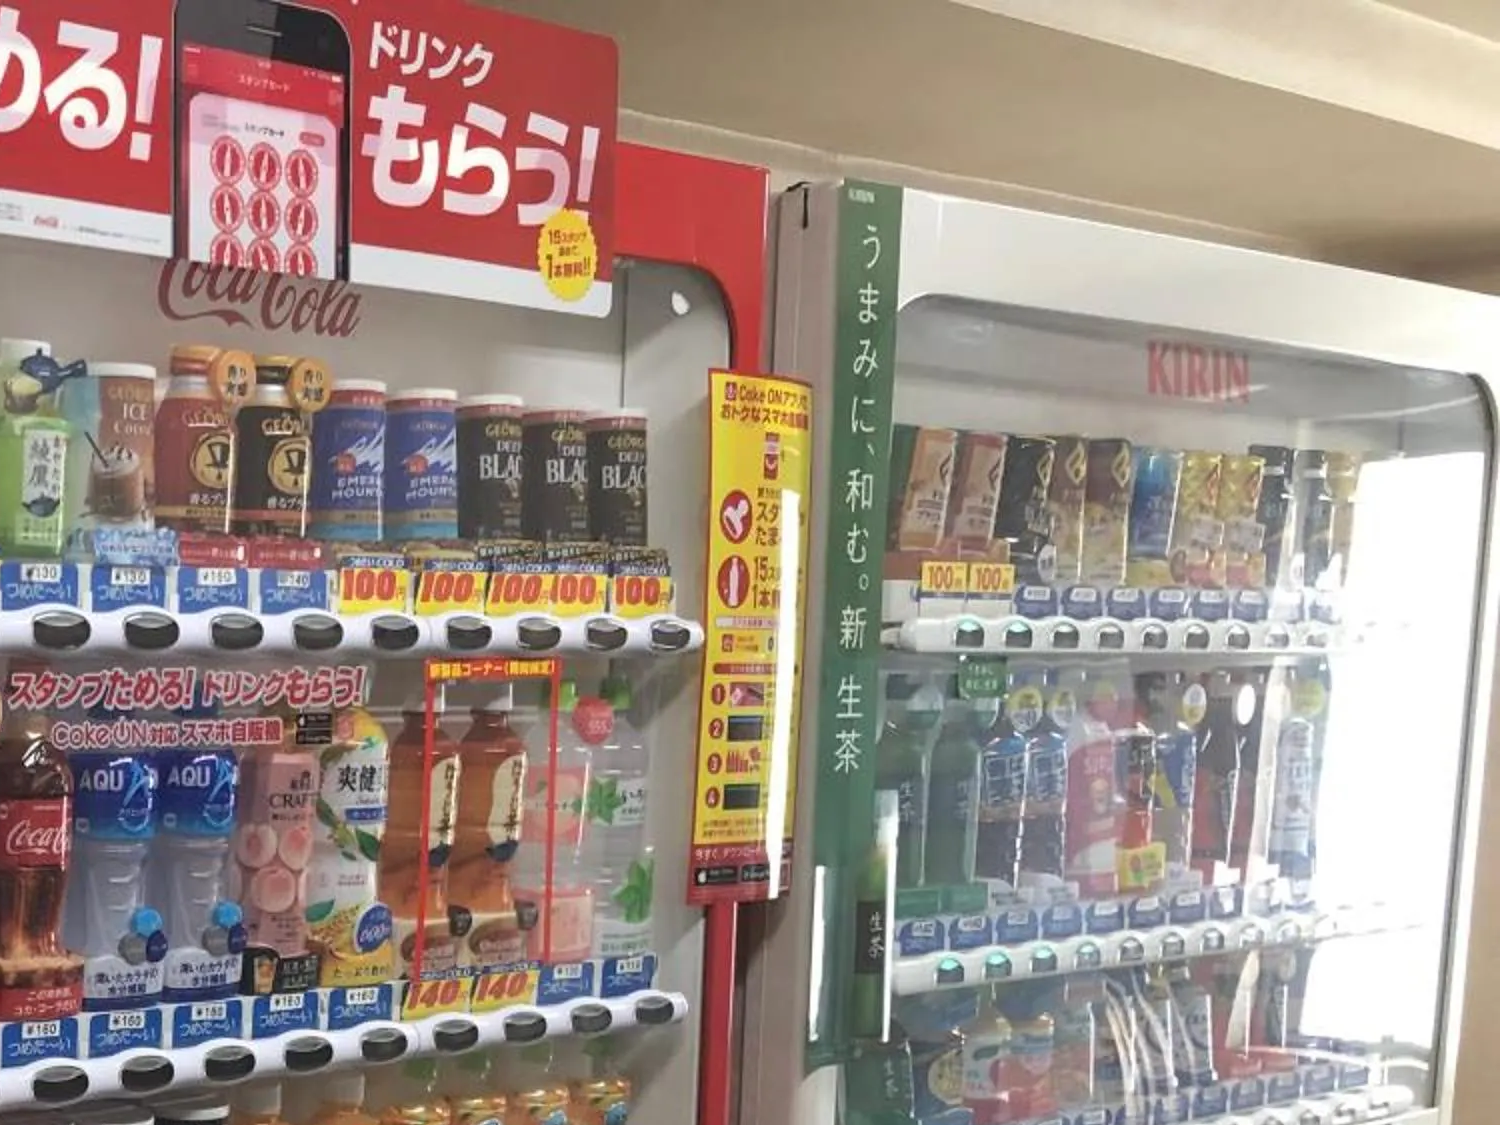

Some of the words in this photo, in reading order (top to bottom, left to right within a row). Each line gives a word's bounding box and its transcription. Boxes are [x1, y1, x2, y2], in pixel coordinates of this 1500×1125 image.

[368, 21, 495, 87] ドリンク
[361, 85, 600, 227] もらう!
[1146, 340, 1250, 403] KIRIN
[479, 454, 522, 480] BLAC
[545, 457, 588, 484] BLAC
[602, 464, 646, 490] BLAC
[8, 664, 196, 711] スタンプためる!
[202, 665, 367, 708] ドリンクもらう!
[51, 721, 111, 751] Coke
[181, 716, 285, 746] スマホ自販機
